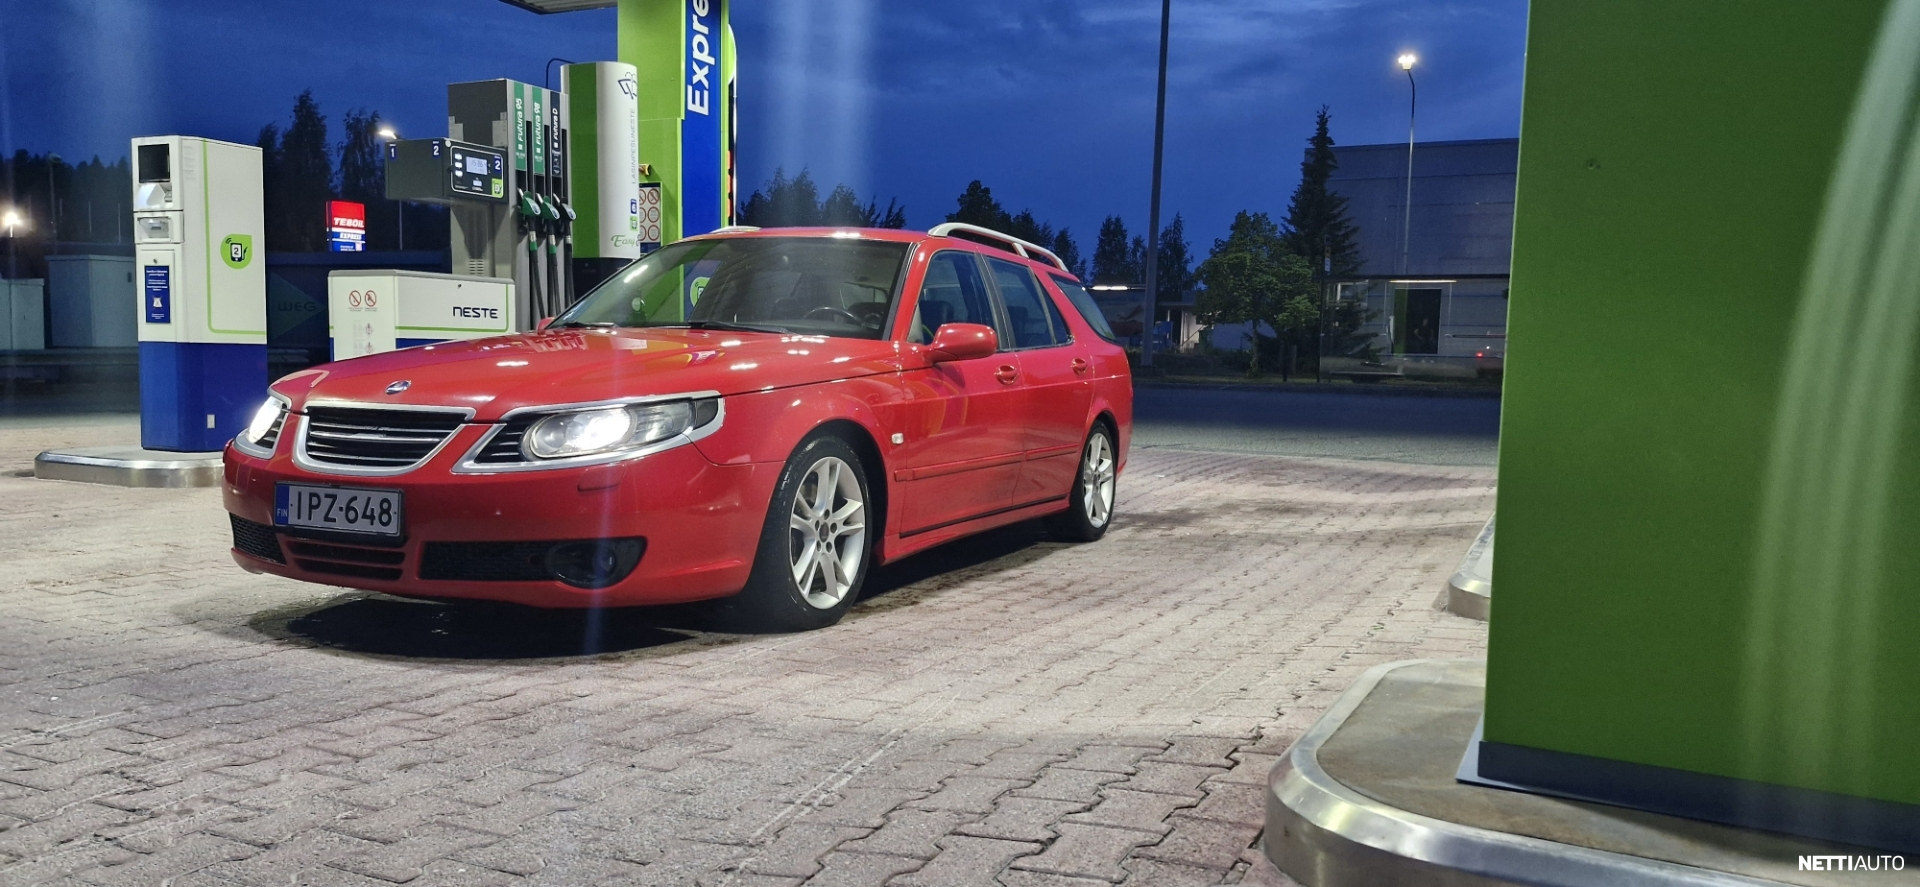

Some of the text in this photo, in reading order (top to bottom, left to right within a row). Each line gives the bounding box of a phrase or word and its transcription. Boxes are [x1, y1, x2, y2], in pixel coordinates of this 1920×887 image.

[687, 0, 716, 116] Expre
[515, 98, 523, 110] 95
[533, 102, 541, 114] 98
[390, 148, 395, 158] 1
[433, 145, 440, 156] 2
[494, 160, 501, 171] 2
[333, 217, 365, 228] TEBOIL
[233, 247, 239, 255] 2
[452, 306, 499, 319] NESTE
[276, 491, 393, 528] FIN IPZ-648
